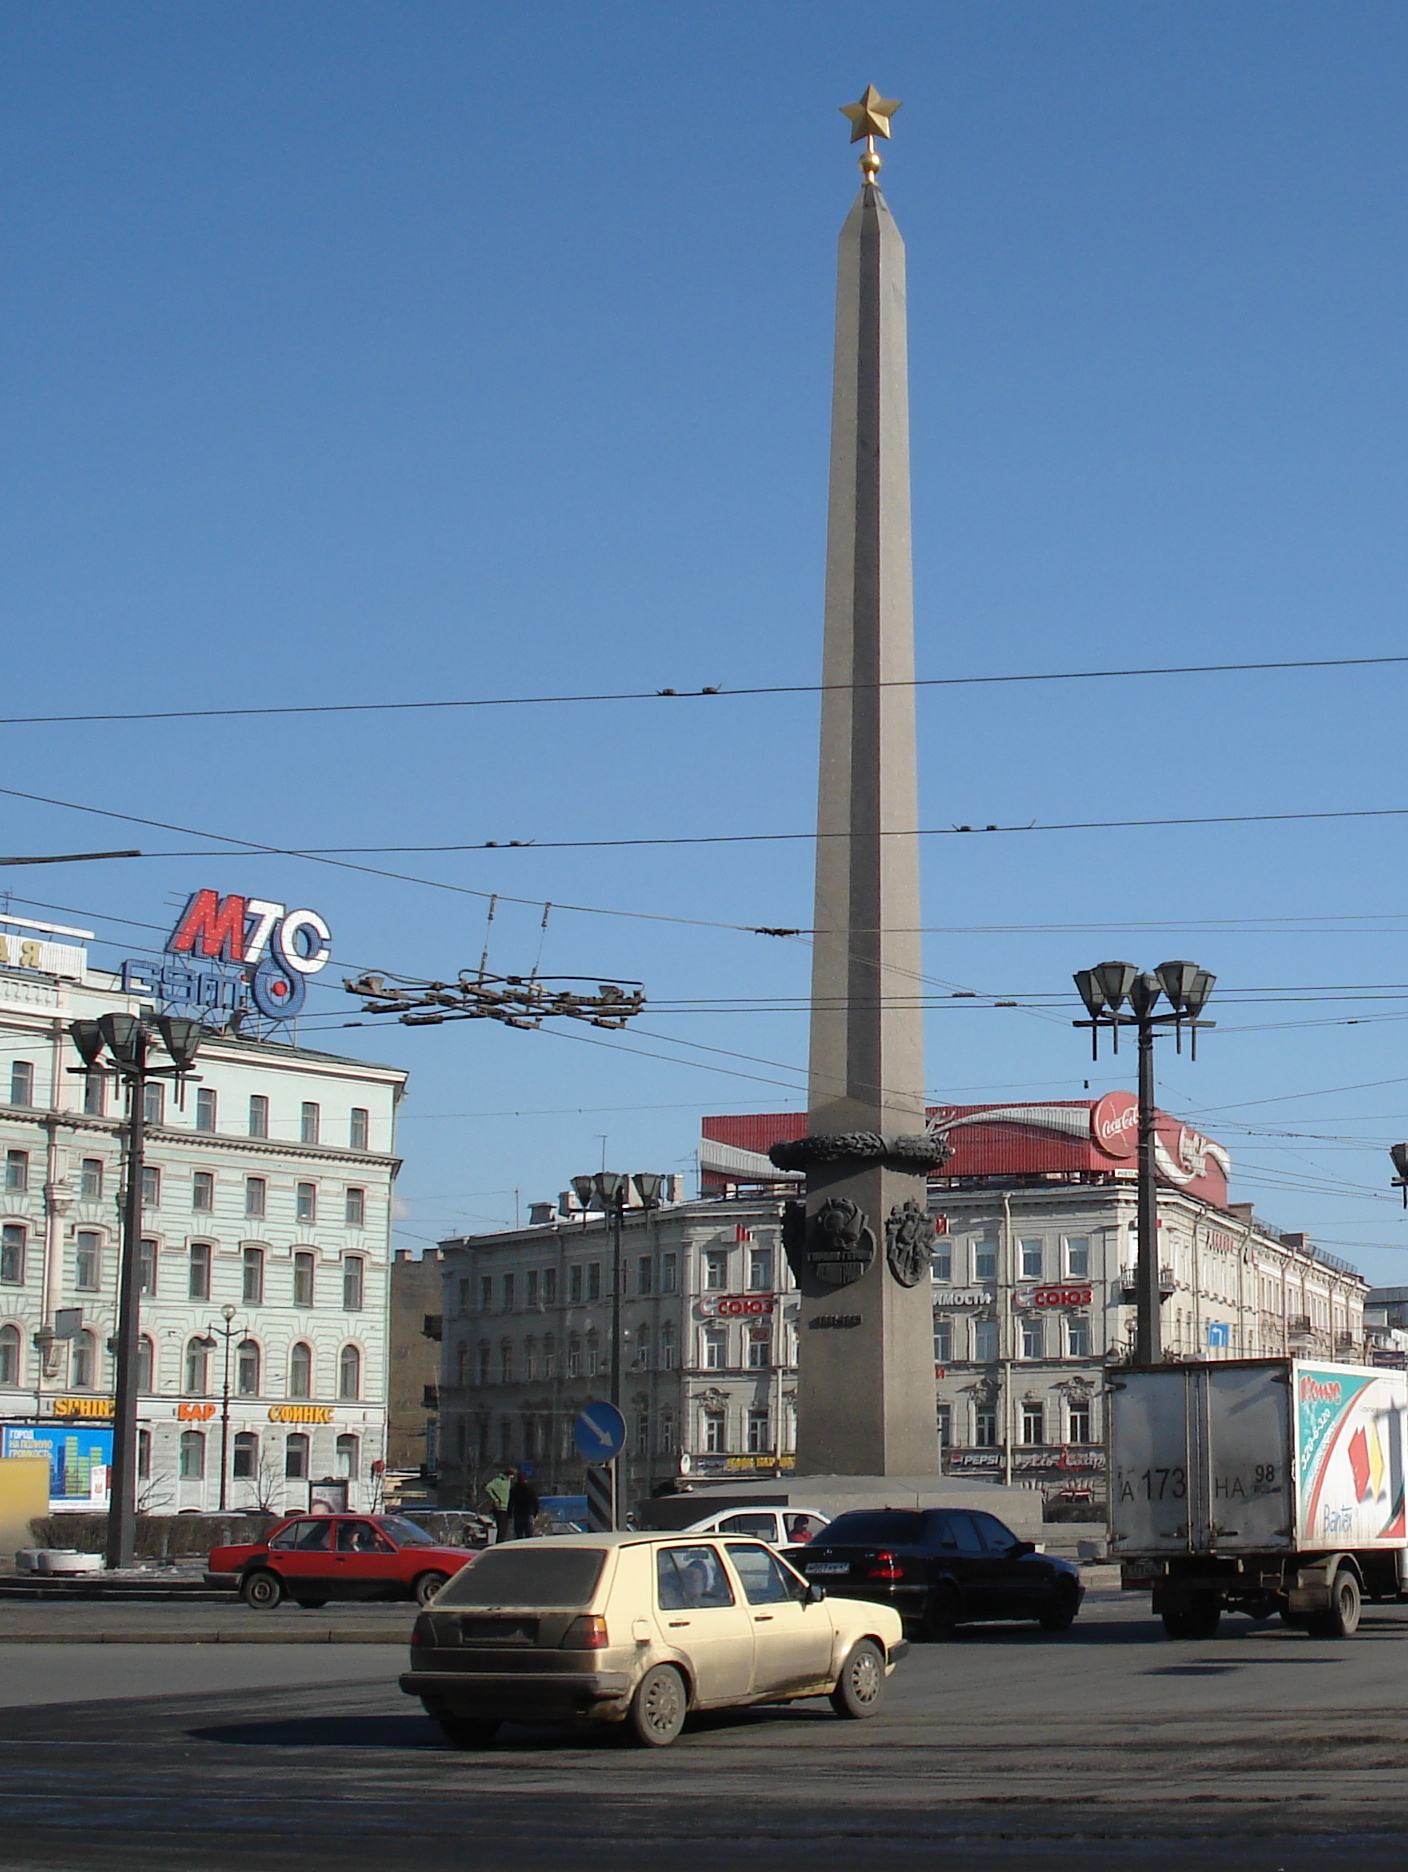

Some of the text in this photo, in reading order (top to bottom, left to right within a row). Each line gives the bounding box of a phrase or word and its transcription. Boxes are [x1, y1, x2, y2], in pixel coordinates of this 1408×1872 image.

[1102, 1104, 1139, 1139] Coca-Col
[932, 1292, 991, 1306] имости
[1034, 1290, 1094, 1306] СОЮЗ
[717, 1300, 775, 1316] СОЮЗ
[53, 1397, 115, 1418] SPHIN
[177, 1403, 216, 1421] БАР
[268, 1405, 334, 1423] СФИНКС
[964, 1454, 999, 1466] PEPSI
[1141, 1468, 1187, 1500] 173
[1255, 1464, 1275, 1483] 98
